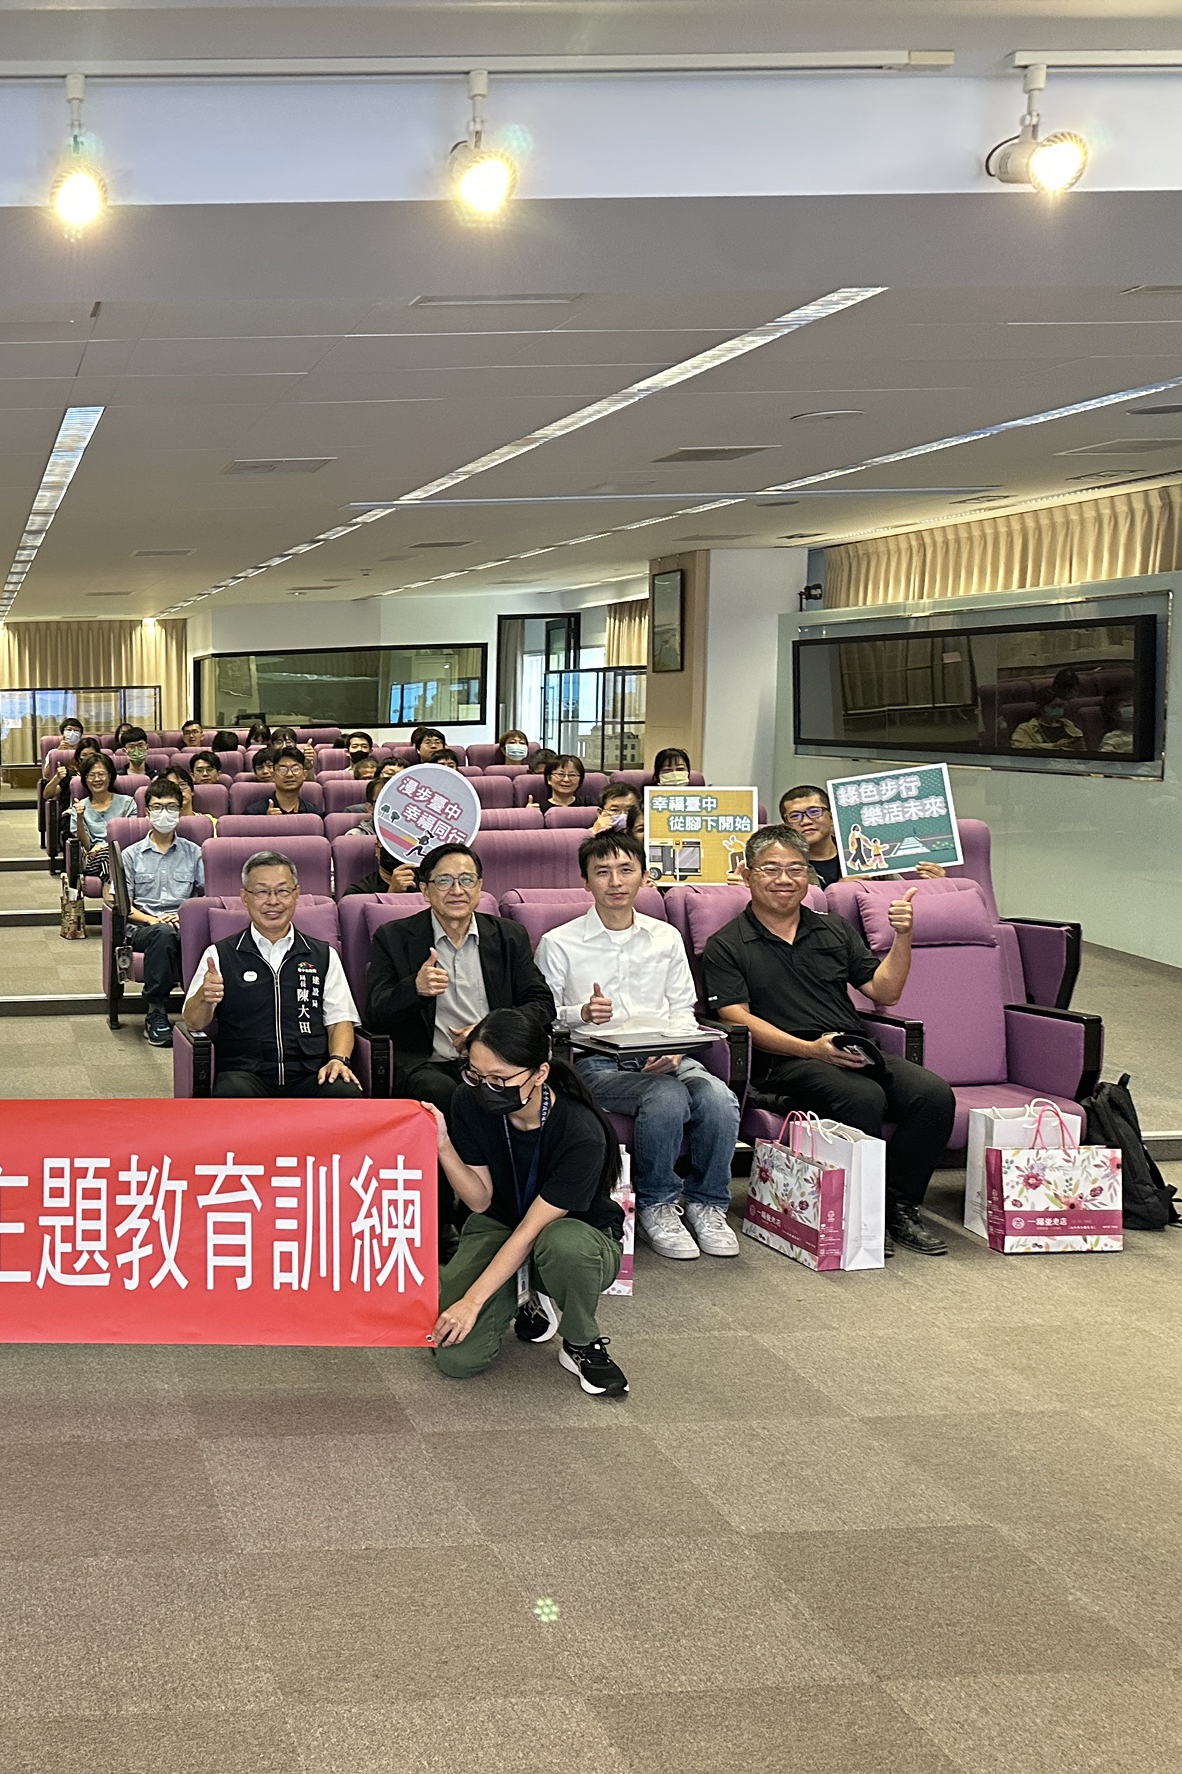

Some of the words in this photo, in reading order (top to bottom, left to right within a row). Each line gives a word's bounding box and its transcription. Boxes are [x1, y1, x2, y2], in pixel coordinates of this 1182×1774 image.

[398, 777, 463, 820] 漫步臺中
[651, 796, 717, 812] 幸福臺中
[838, 777, 920, 805] 綠色步行
[402, 804, 468, 844] 幸福同行
[668, 815, 752, 832] 從腳下開始
[861, 796, 947, 825] 樂活未來
[297, 988, 312, 1034] 陳大田
